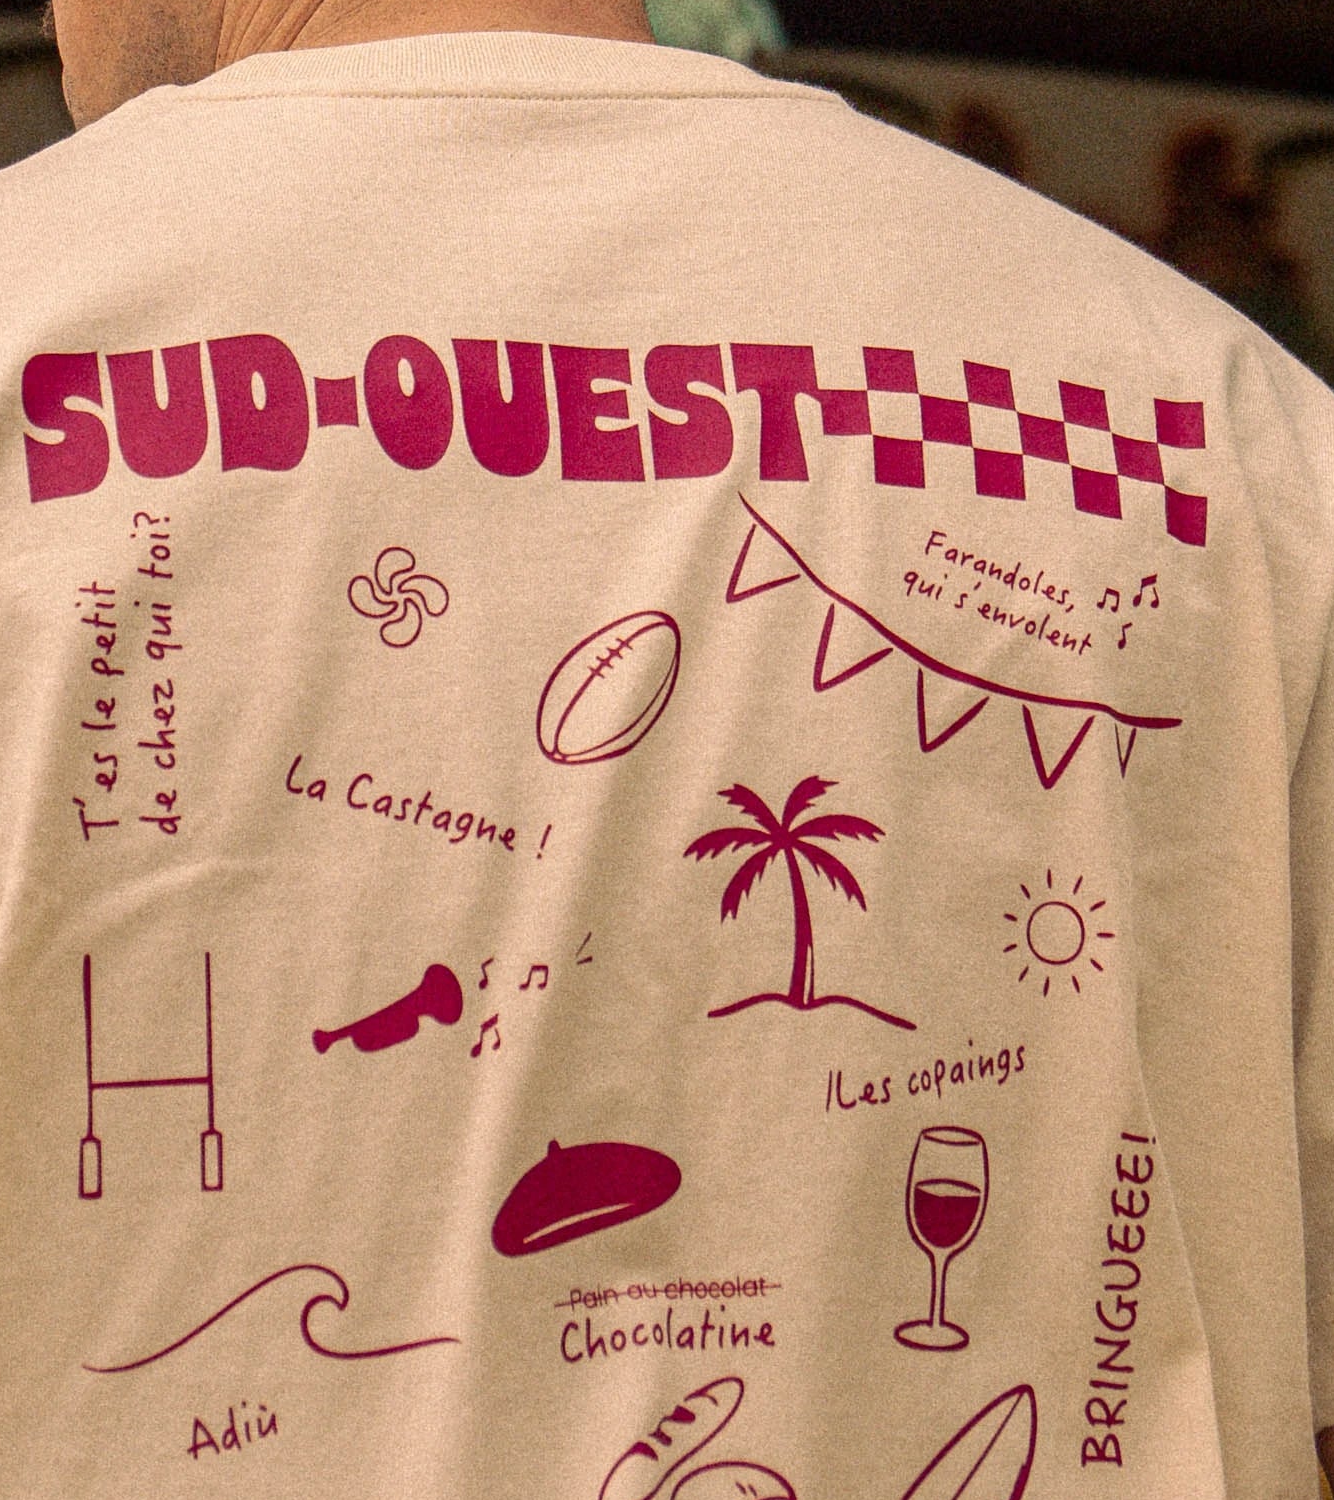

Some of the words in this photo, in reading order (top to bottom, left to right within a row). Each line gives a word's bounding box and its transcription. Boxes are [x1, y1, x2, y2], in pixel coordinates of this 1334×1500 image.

[22, 333, 818, 503] SUD-OUEST
[129, 510, 174, 580] toi?
[924, 530, 1075, 613] Farandoles,
[75, 580, 126, 677] petit
[132, 599, 183, 661] qui
[903, 570, 950, 601] qui
[953, 580, 1093, 656] s'envolent
[80, 696, 117, 730] le
[137, 678, 176, 771] chez
[72, 748, 121, 842] T'es
[138, 789, 183, 836] de
[285, 753, 328, 802] La
[346, 772, 517, 852] Castagne
[908, 1038, 1025, 1099] copaings
[560, 1303, 777, 1364] Chocolatine
[568, 1286, 619, 1311] Pain
[626, 1282, 658, 1300] au
[664, 1275, 768, 1299] chocolat
[1080, 1131, 1157, 1468] BRINGUEEE!
